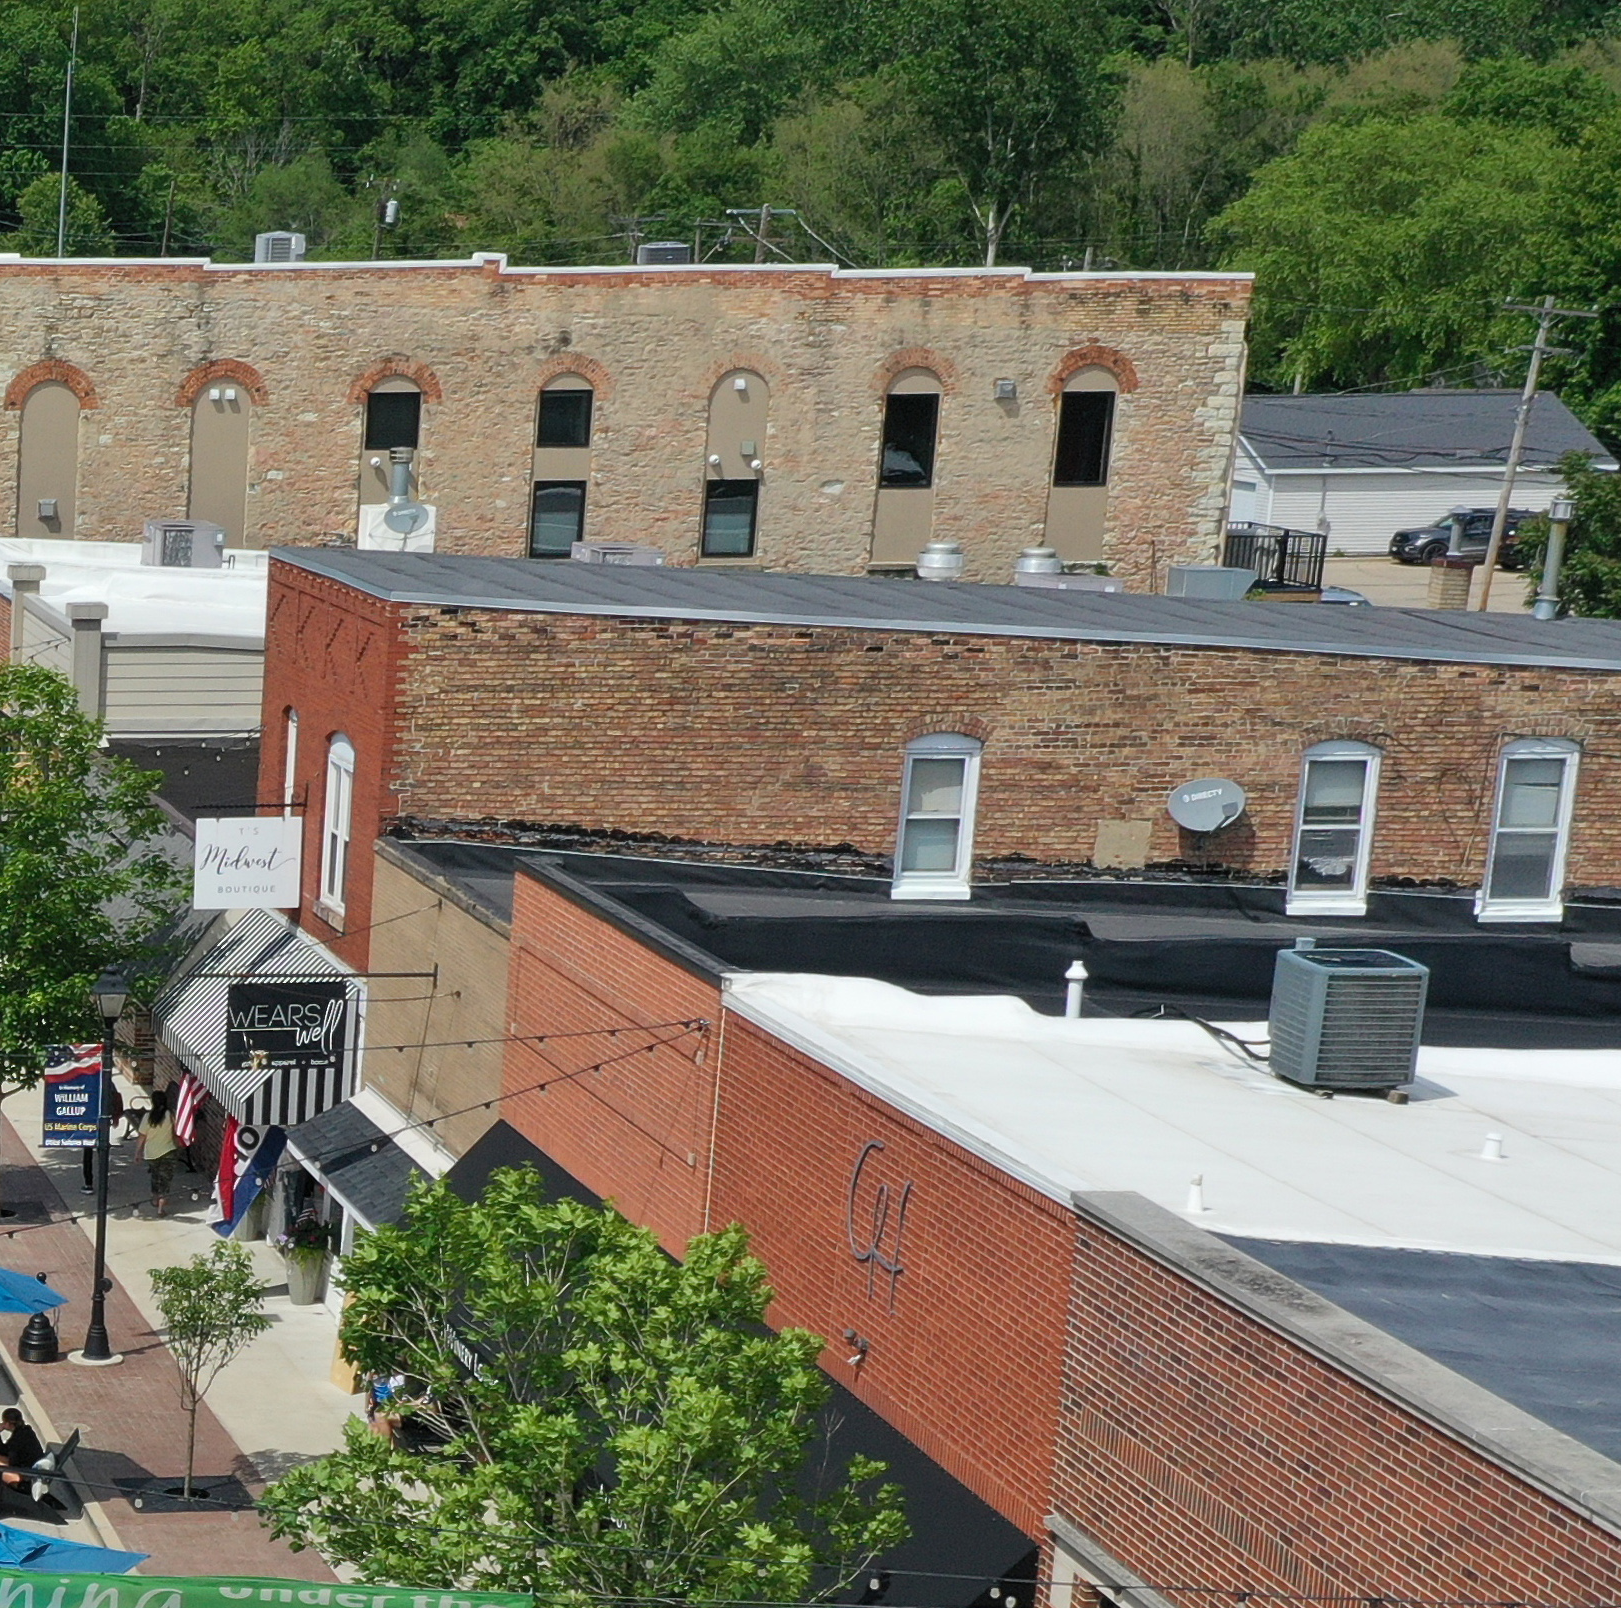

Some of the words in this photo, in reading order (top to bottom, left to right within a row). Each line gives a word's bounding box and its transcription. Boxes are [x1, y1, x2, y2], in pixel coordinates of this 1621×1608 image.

[200, 844, 297, 875] Midwest
[217, 885, 275, 894] BOUTIQUE
[229, 1003, 321, 1028] WEARS
[295, 999, 344, 1055] well
[54, 1093, 89, 1103] WILLIAM
[56, 1106, 86, 1116] GALLUP
